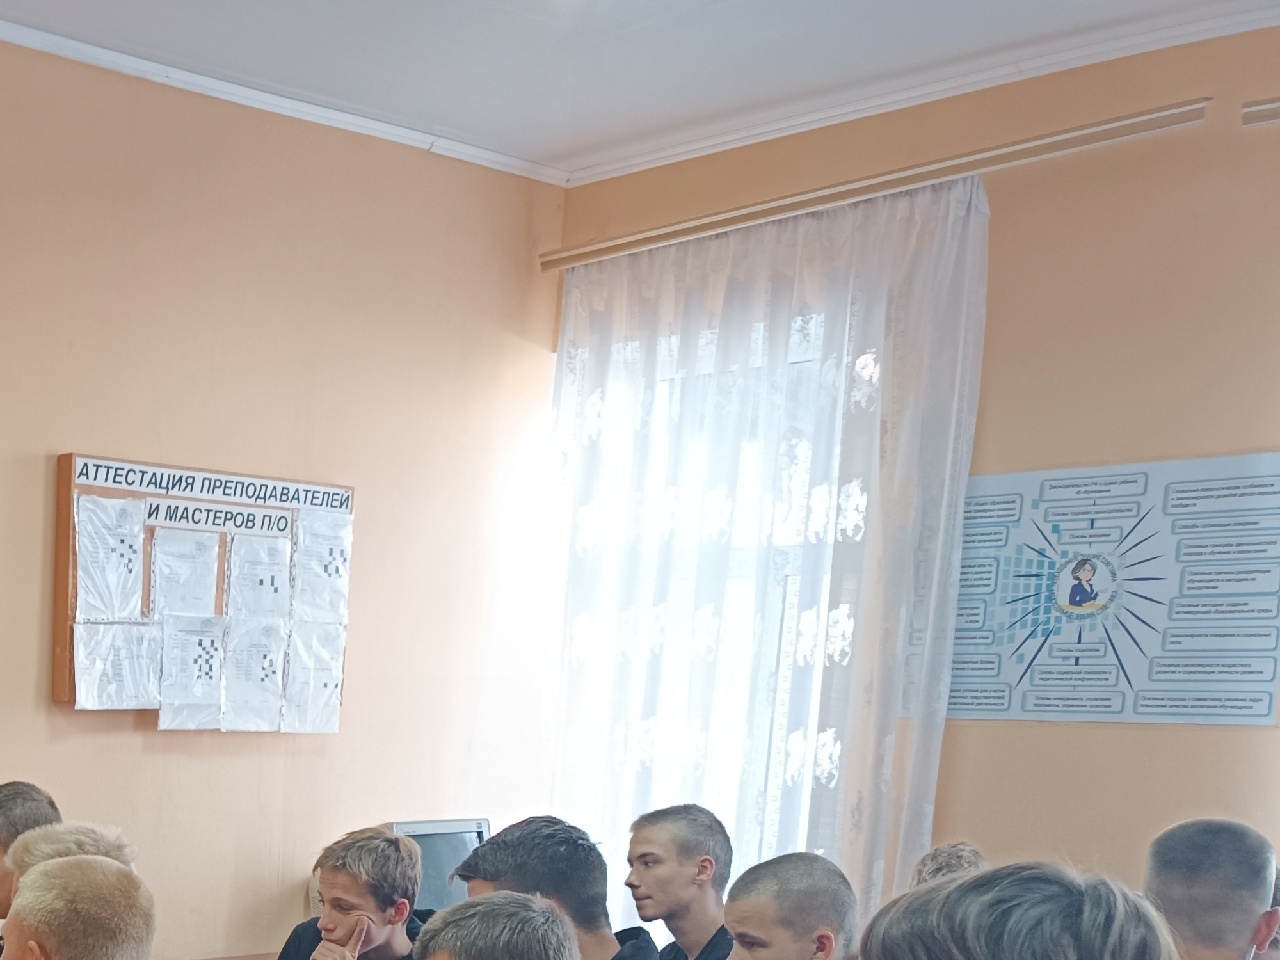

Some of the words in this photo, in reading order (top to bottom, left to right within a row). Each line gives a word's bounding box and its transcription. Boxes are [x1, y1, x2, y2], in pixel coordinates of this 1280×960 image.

[77, 462, 196, 495] АТТЕСТАЦИЯ
[200, 476, 351, 510] ПРЕПОДАВАТЕЛЕЙ
[147, 502, 161, 520] И
[164, 505, 256, 530] МАСТЕРОВ
[260, 514, 289, 532] П/О
